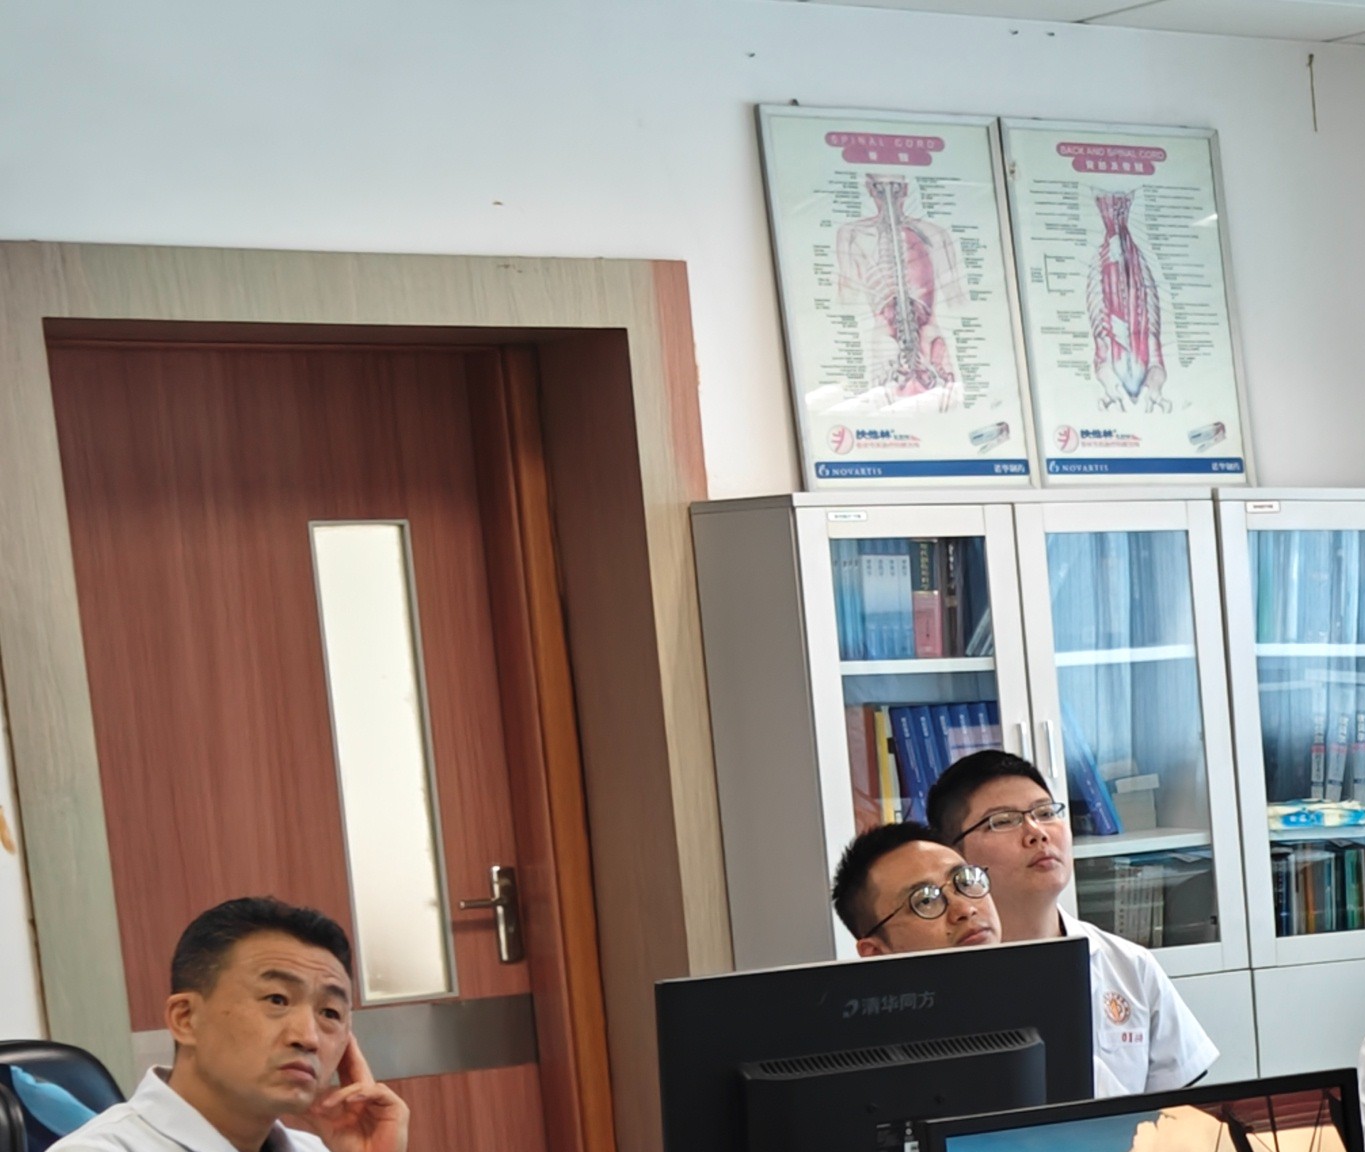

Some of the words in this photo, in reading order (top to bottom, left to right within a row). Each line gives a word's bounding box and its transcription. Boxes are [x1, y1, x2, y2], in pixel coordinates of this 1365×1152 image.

[829, 133, 885, 149] SPINAL
[898, 137, 936, 150] CORD
[1060, 145, 1084, 155] BACK
[1085, 147, 1105, 156] AND
[1107, 148, 1139, 157] SPINAL
[1141, 150, 1165, 160] CORD
[831, 467, 883, 476] NOVARTIS
[1062, 463, 1109, 472] NOVARTIS
[861, 990, 936, 1015] 清华同方
